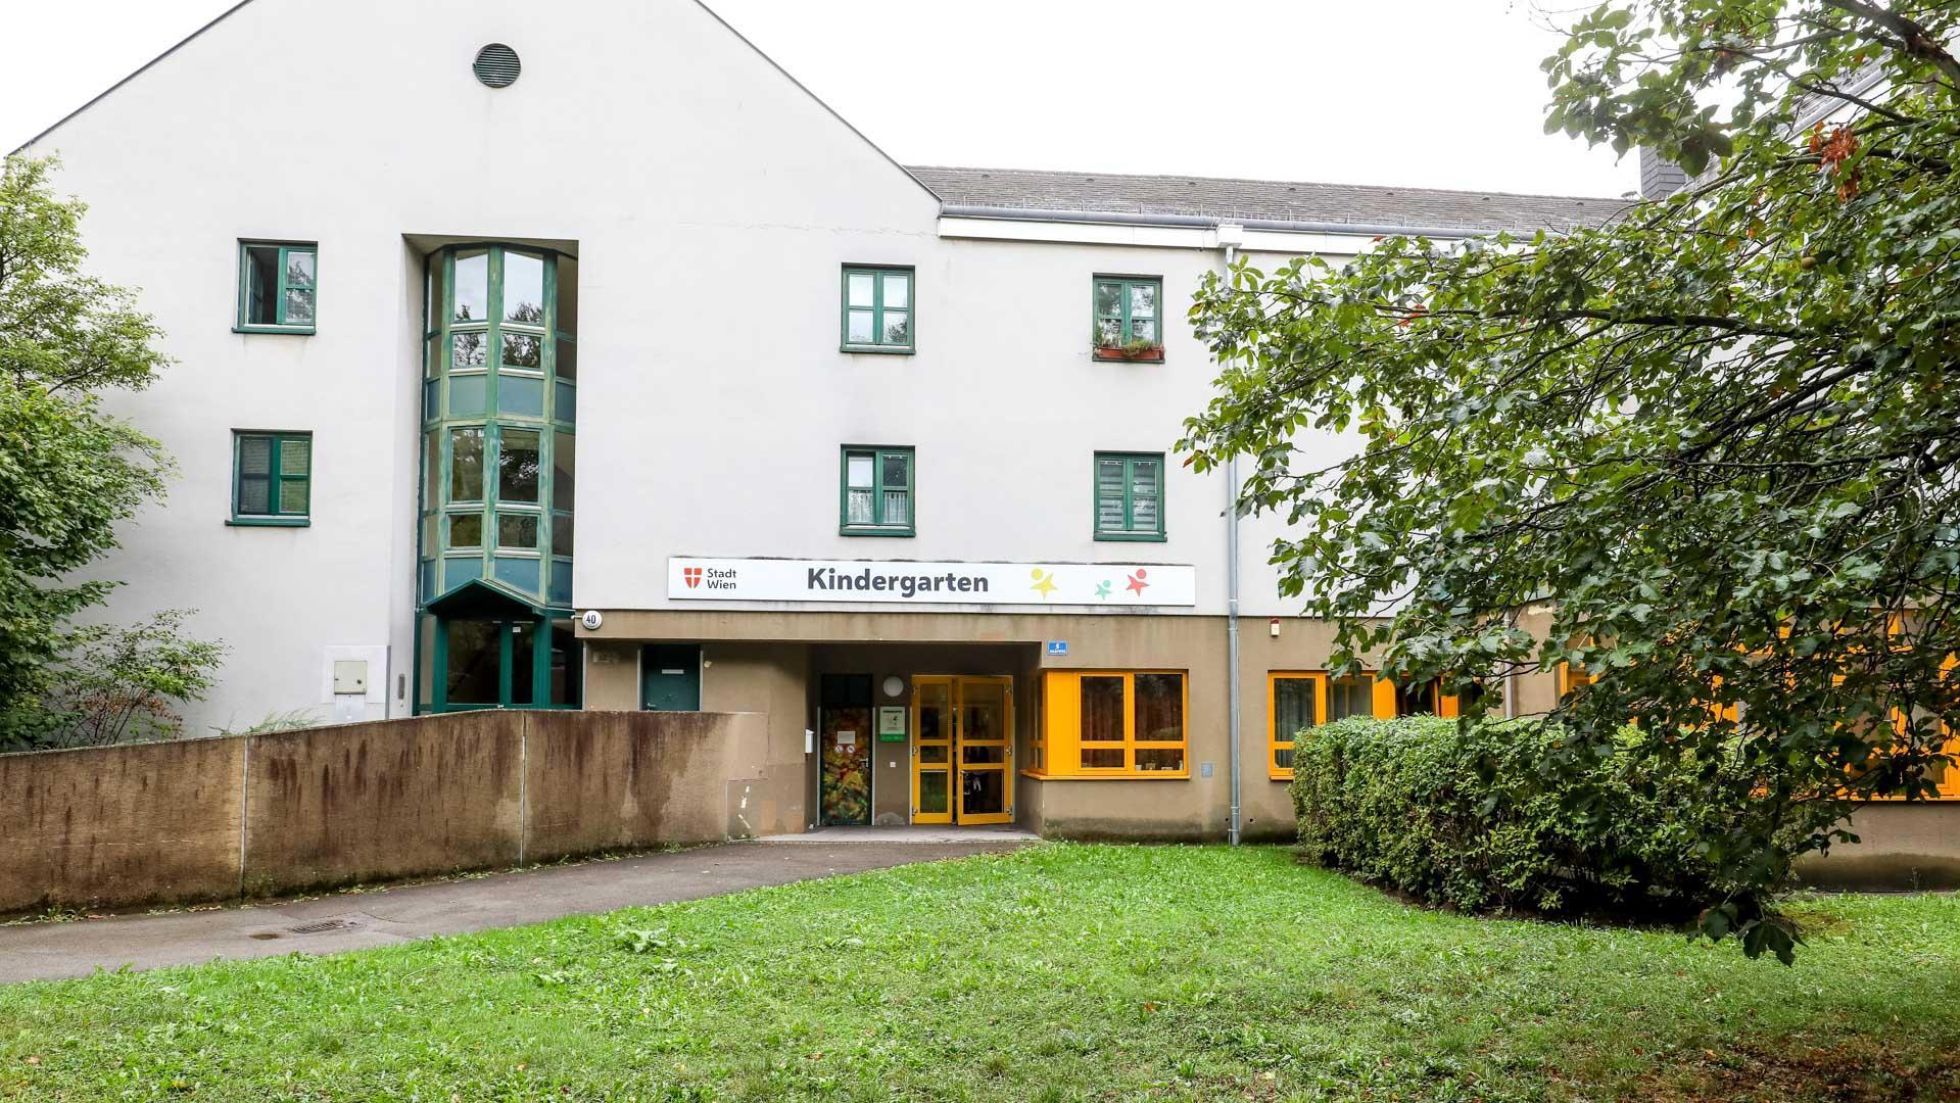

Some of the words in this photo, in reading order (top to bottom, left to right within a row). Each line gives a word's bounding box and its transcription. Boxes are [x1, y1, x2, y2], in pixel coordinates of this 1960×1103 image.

[707, 568, 737, 578] Stadt
[707, 579, 737, 589] Wien
[807, 568, 989, 597] Kindergarten
[586, 614, 597, 624] 40
